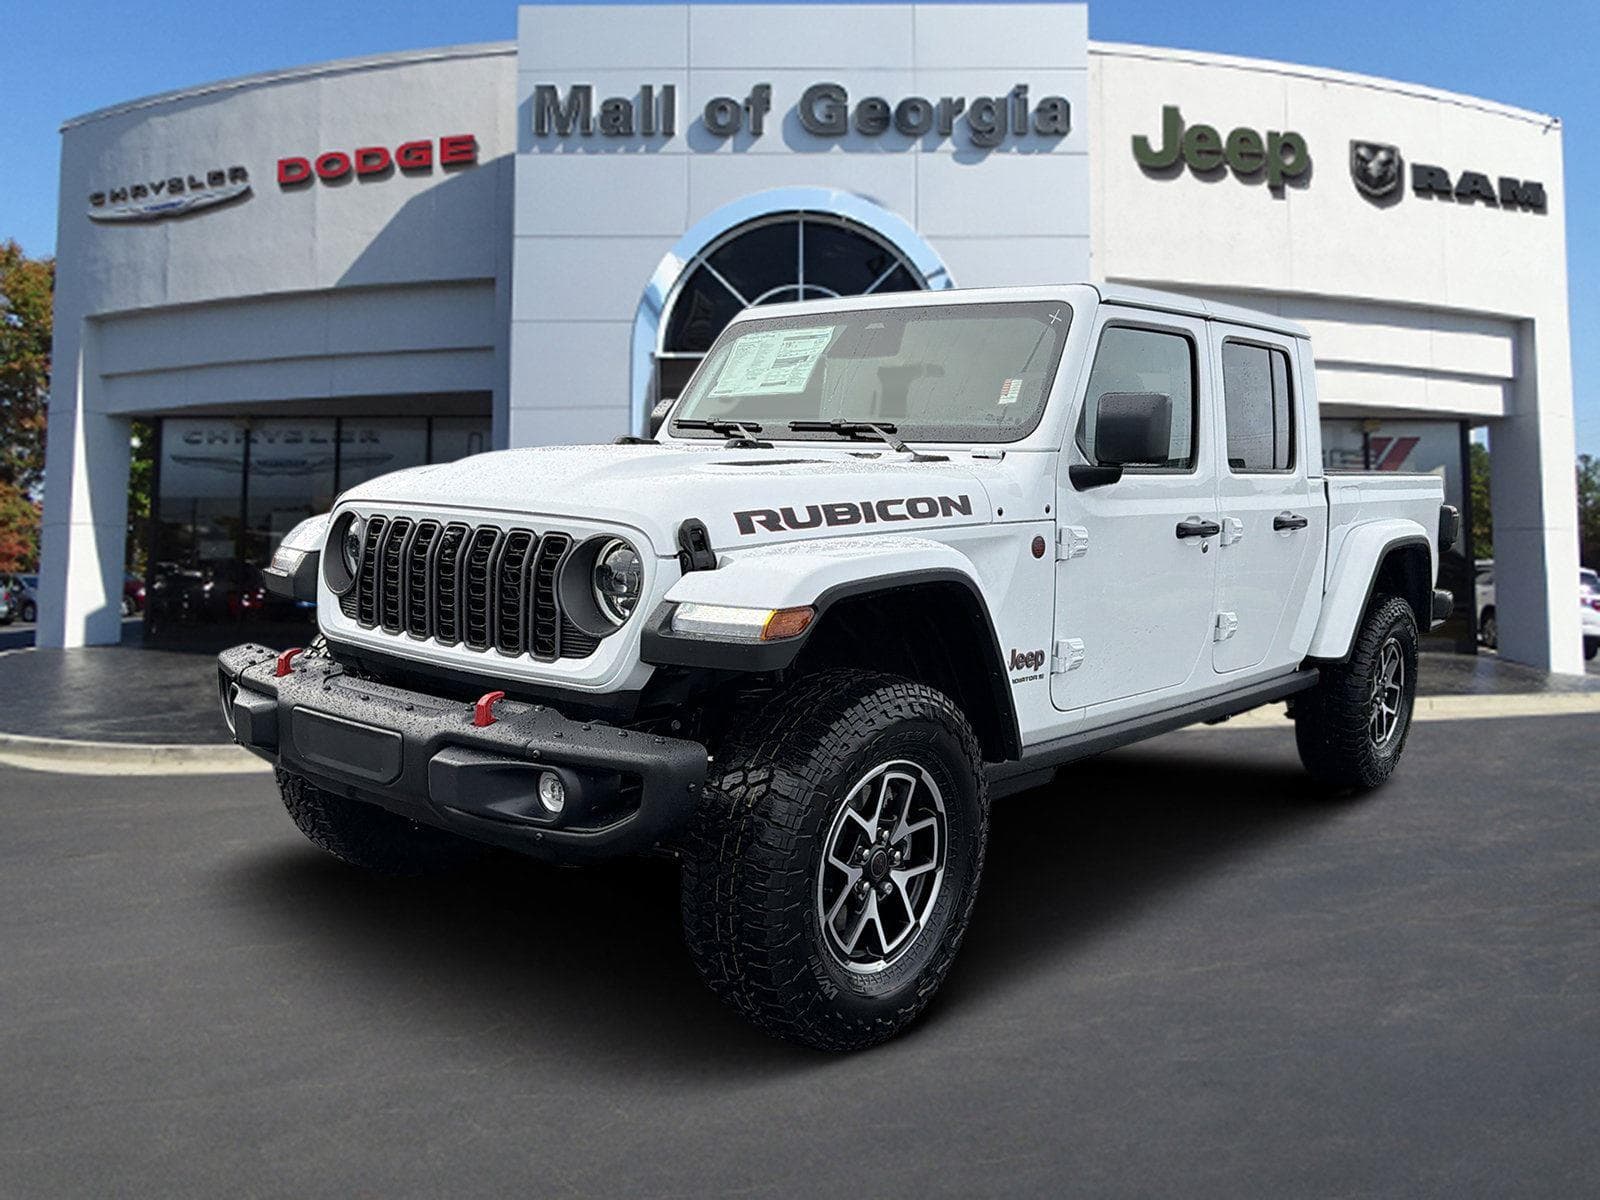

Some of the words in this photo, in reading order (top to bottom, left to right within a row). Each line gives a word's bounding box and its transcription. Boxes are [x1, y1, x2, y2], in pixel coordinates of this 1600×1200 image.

[533, 85, 676, 136] Mall
[703, 83, 772, 136] of
[799, 83, 1072, 148] Georgia
[277, 134, 478, 186] DODGE
[1131, 105, 1310, 190] Jeep
[89, 166, 249, 206] CHRYSLER
[1411, 162, 1547, 213] RAM
[182, 430, 381, 444] CHRYSLER
[733, 495, 973, 535] RUBICON
[1009, 648, 1046, 672] Jeep
